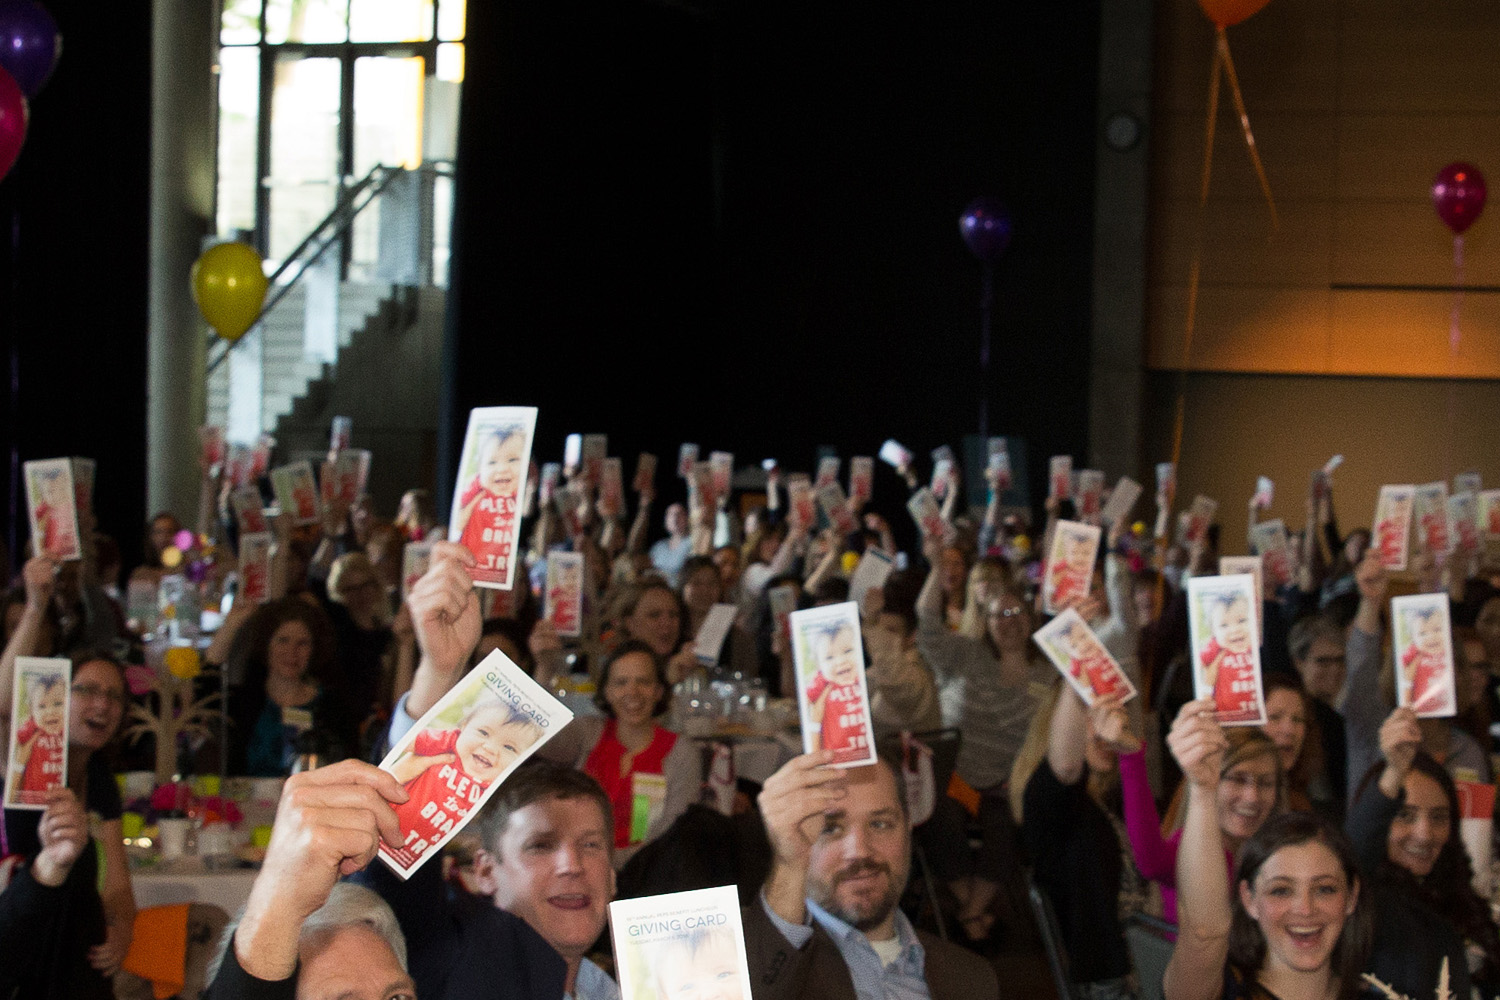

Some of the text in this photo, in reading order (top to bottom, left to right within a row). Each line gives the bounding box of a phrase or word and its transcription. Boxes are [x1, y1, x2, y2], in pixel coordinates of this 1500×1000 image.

[486, 672, 521, 705] GIVING
[521, 702, 550, 728] CARD
[628, 914, 727, 936] GIVING CARD
